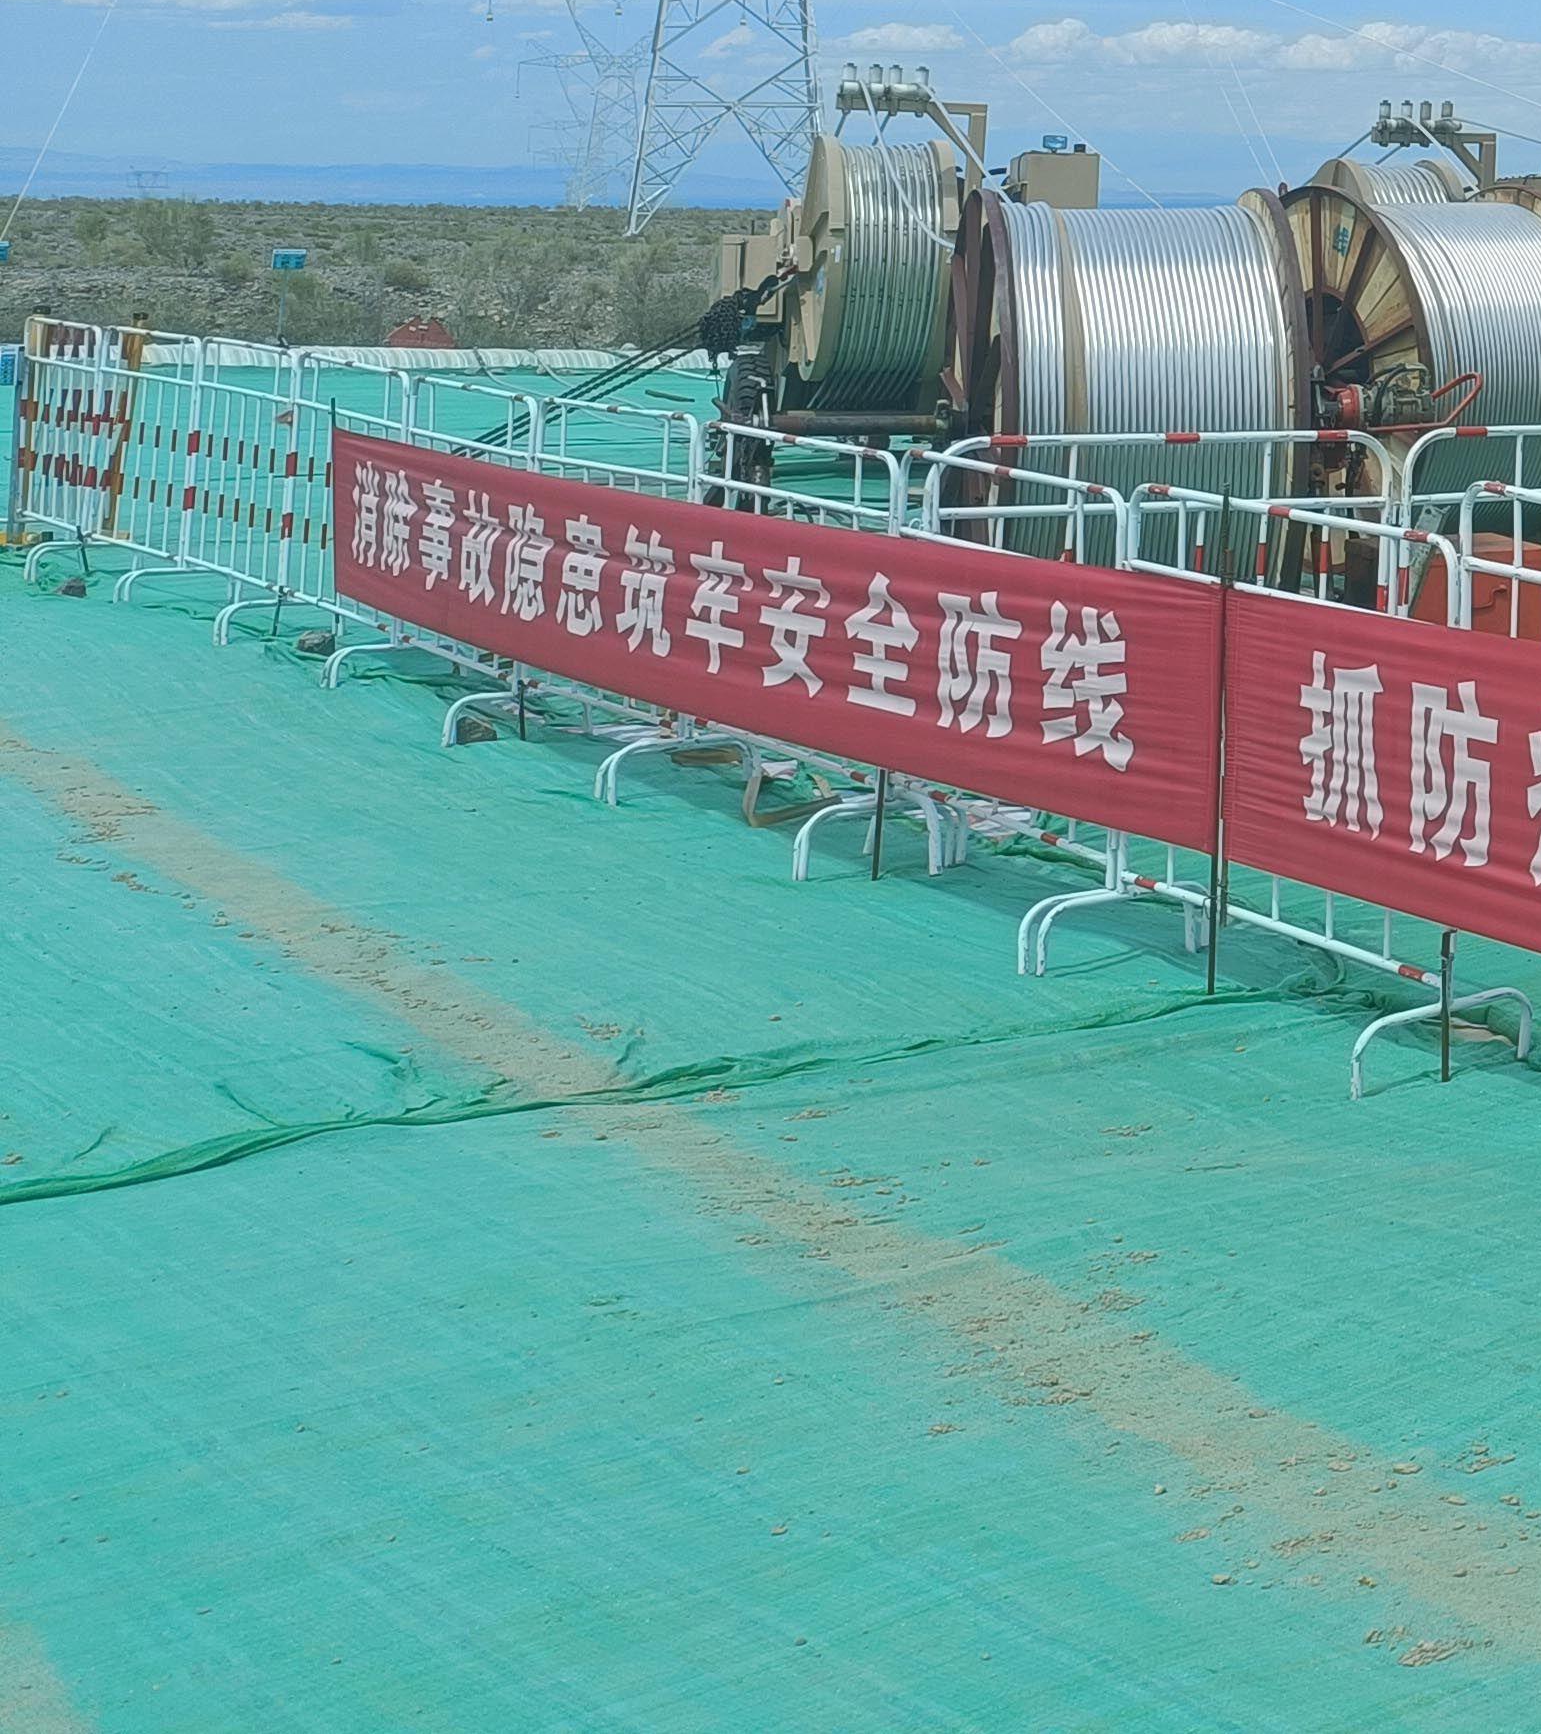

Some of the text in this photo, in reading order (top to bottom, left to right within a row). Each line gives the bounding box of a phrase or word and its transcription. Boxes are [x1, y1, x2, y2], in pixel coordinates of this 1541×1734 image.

[350, 460, 1136, 773] 消除事故隐患筑牢安全防线
